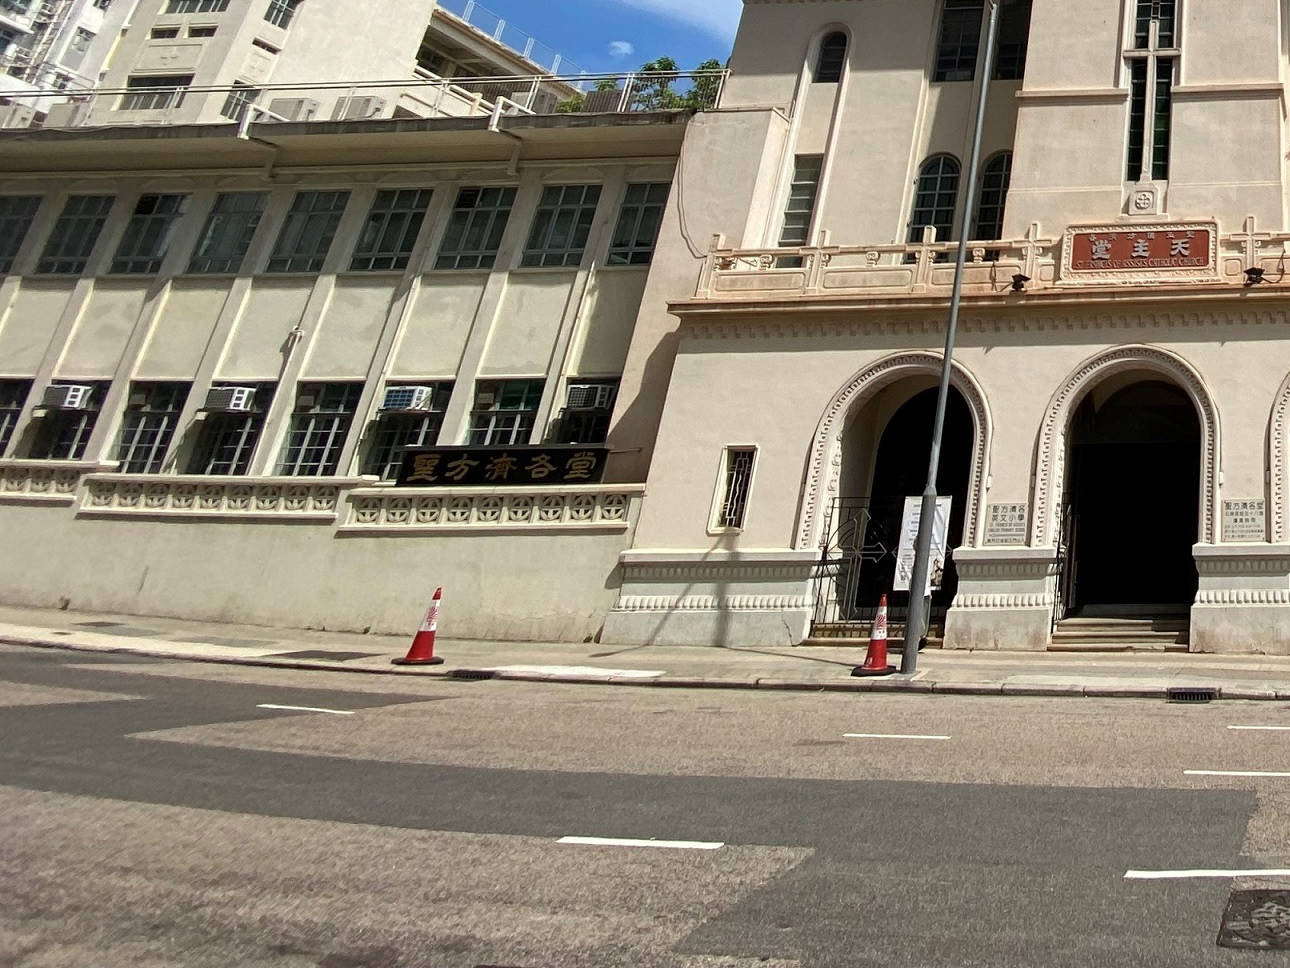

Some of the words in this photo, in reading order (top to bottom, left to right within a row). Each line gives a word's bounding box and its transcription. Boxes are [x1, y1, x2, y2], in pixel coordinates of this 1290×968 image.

[1091, 239, 1190, 259] 天主堂
[406, 451, 596, 481] 聖方濟各堂
